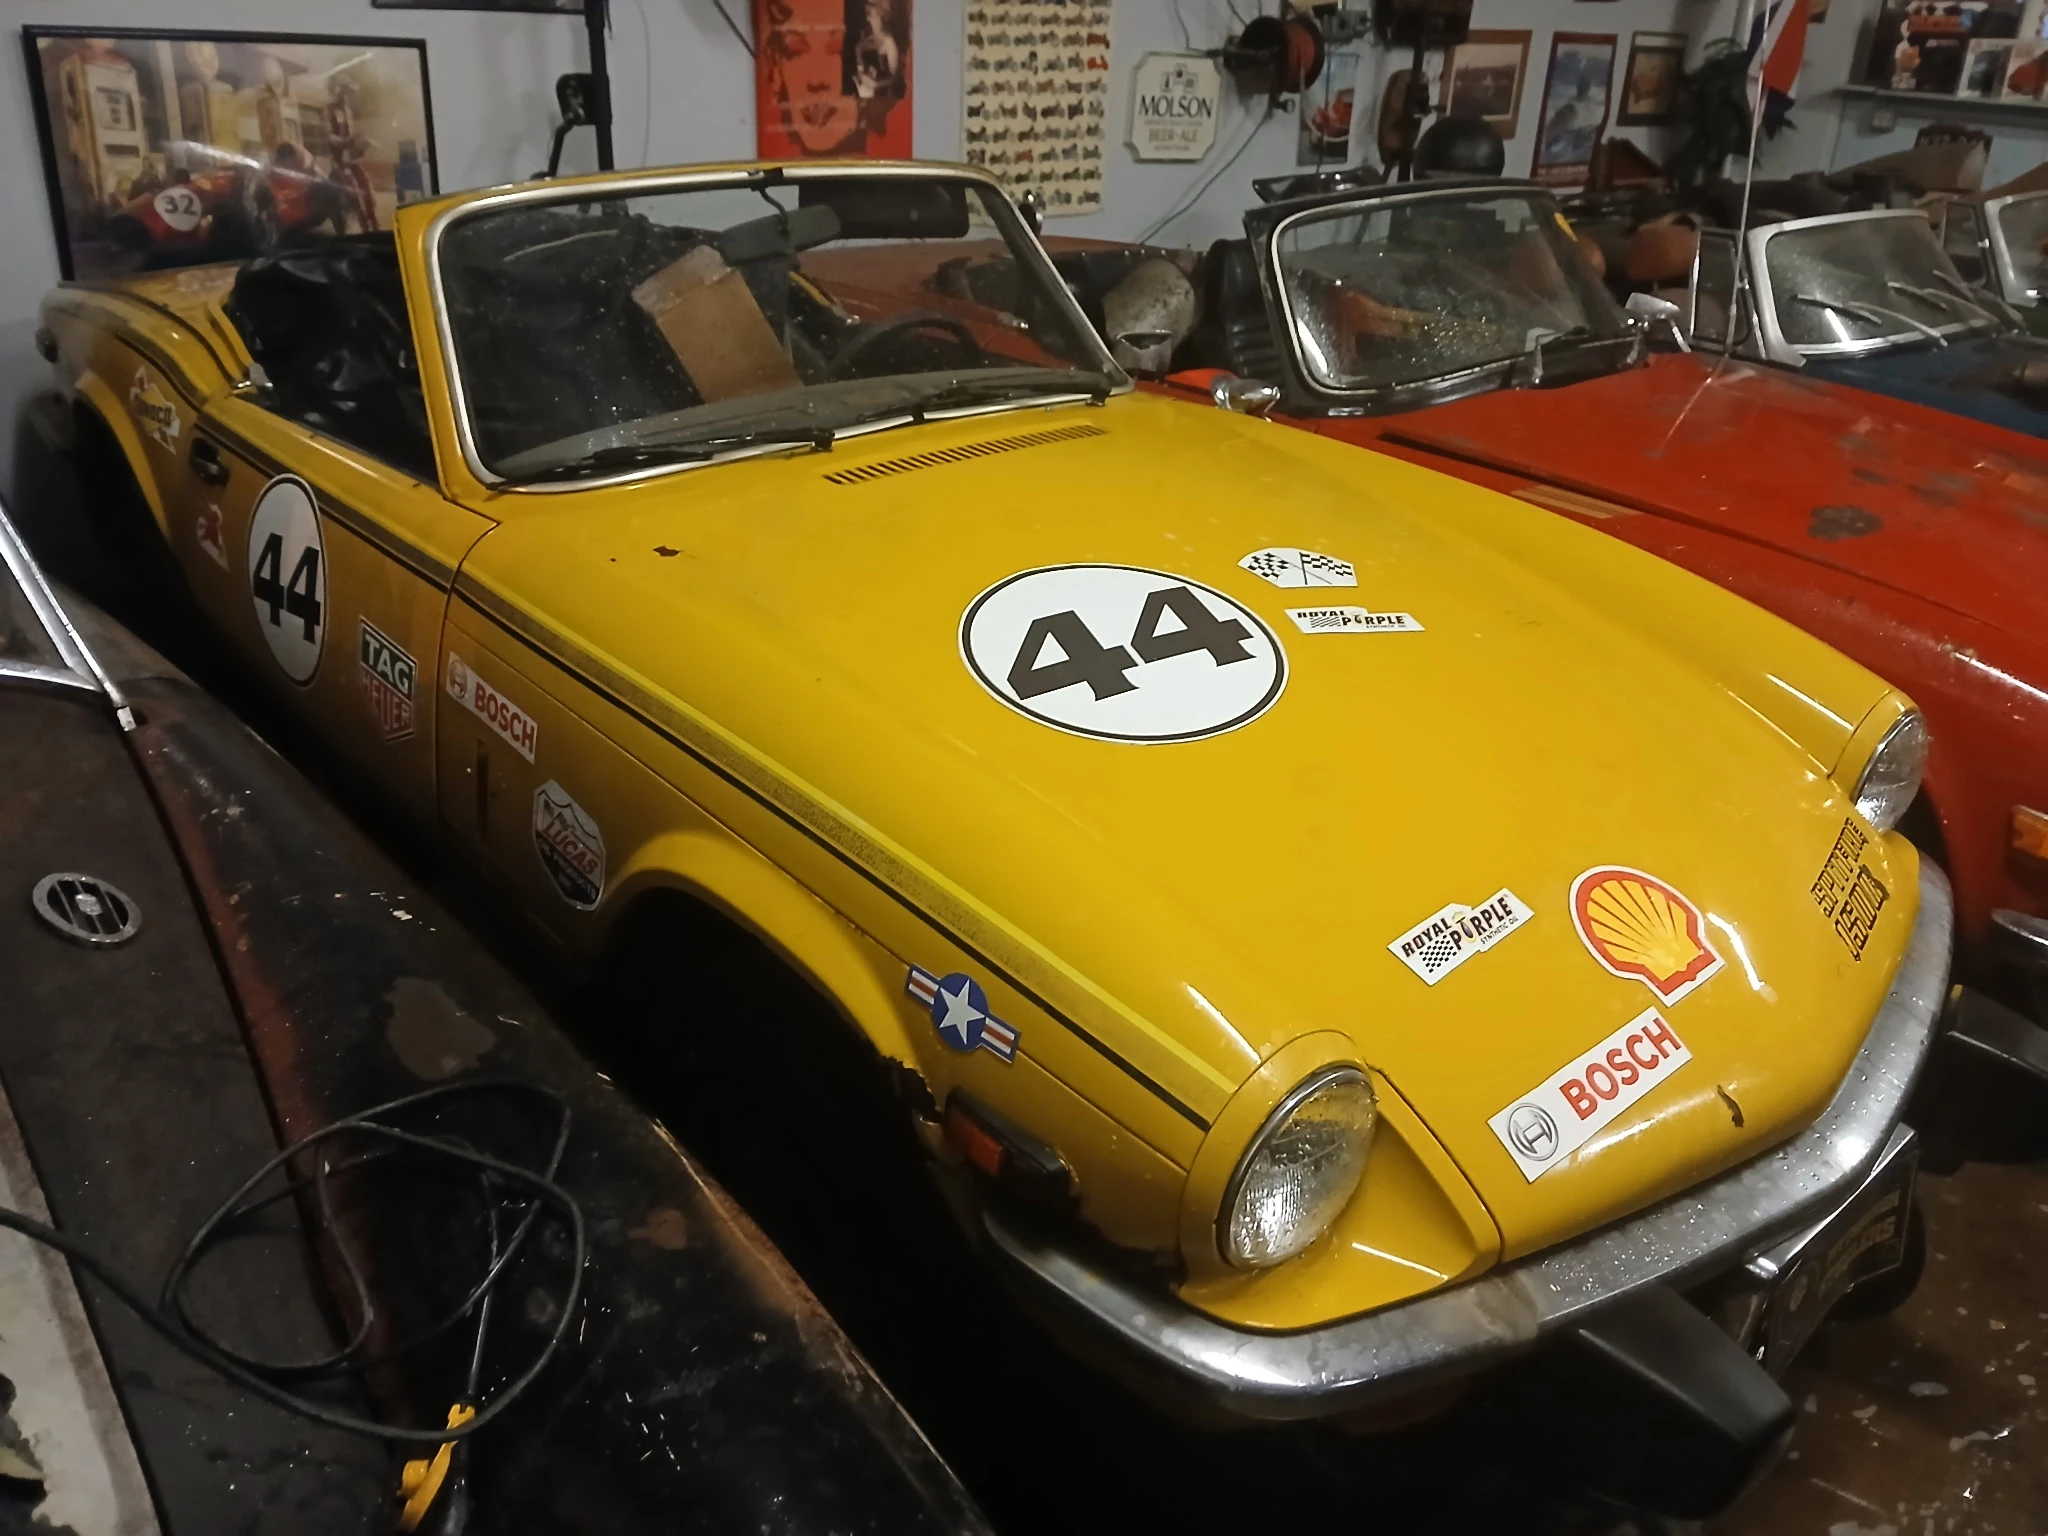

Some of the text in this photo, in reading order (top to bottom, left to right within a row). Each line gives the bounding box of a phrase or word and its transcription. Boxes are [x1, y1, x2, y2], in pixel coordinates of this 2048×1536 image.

[1138, 95, 1214, 118] MOLSON
[162, 194, 198, 217] 32
[252, 532, 321, 645] 44
[364, 633, 410, 694] TAG
[1006, 585, 1258, 702] 44
[360, 669, 411, 732] HEUER
[474, 681, 535, 753] BOSCH
[542, 820, 599, 875] LUCAS
[1401, 917, 1452, 958] ROYAL
[1449, 896, 1513, 951] PURPLE
[1480, 921, 1508, 944] SYNTHETIC
[1558, 1017, 1682, 1121] BOSCH
